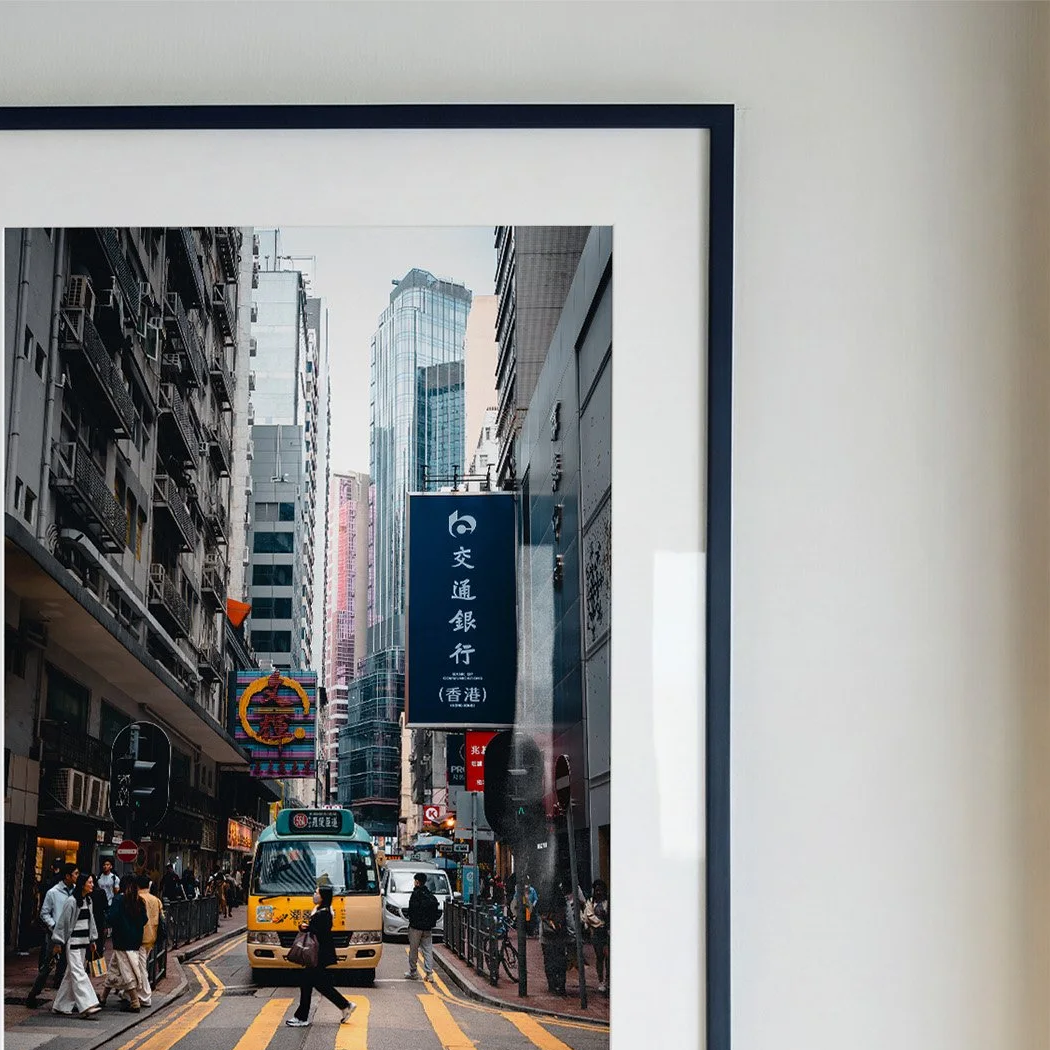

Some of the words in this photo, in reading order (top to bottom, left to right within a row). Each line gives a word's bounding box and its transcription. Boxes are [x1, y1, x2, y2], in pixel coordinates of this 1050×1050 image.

[448, 546, 477, 665] 交通銀行
[438, 686, 487, 703] (香港)
